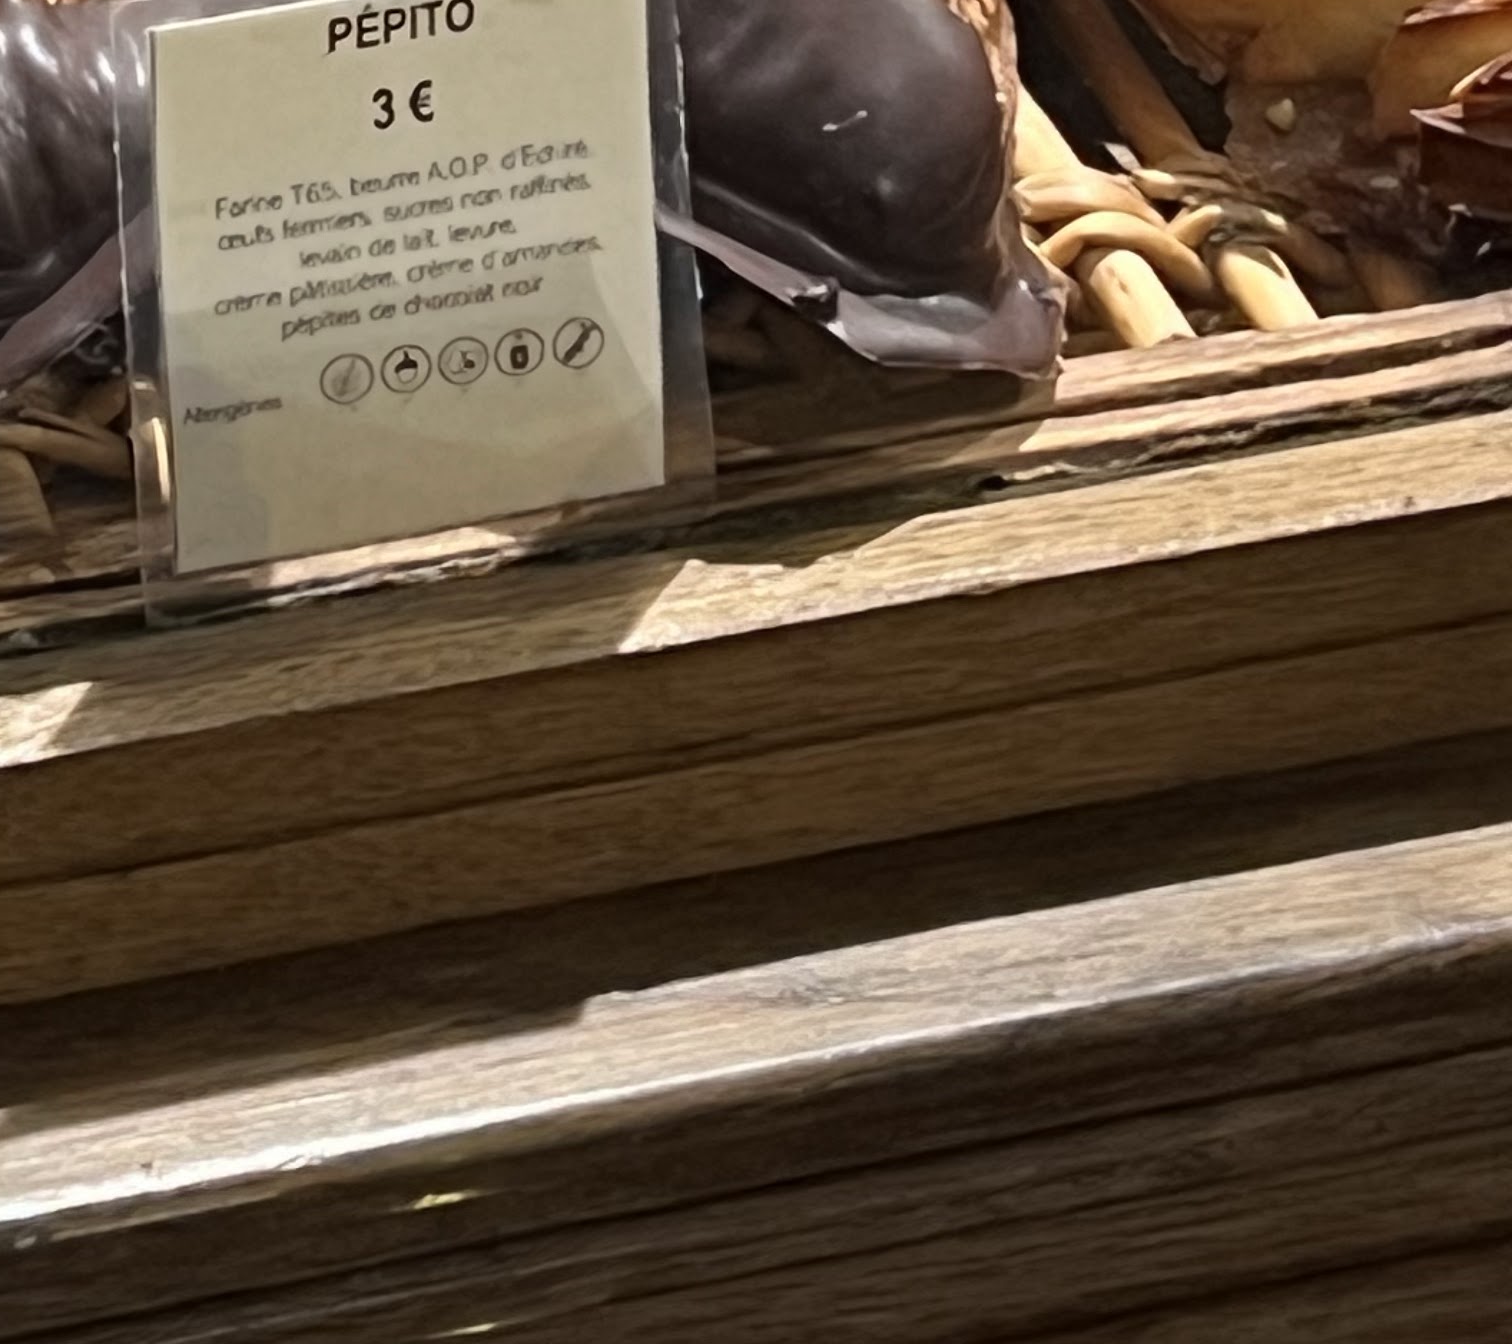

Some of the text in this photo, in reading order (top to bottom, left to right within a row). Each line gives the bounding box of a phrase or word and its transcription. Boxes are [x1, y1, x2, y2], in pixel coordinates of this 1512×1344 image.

[372, 79, 435, 130] 3 €
[215, 194, 284, 221] Farine
[350, 171, 421, 196] beurre
